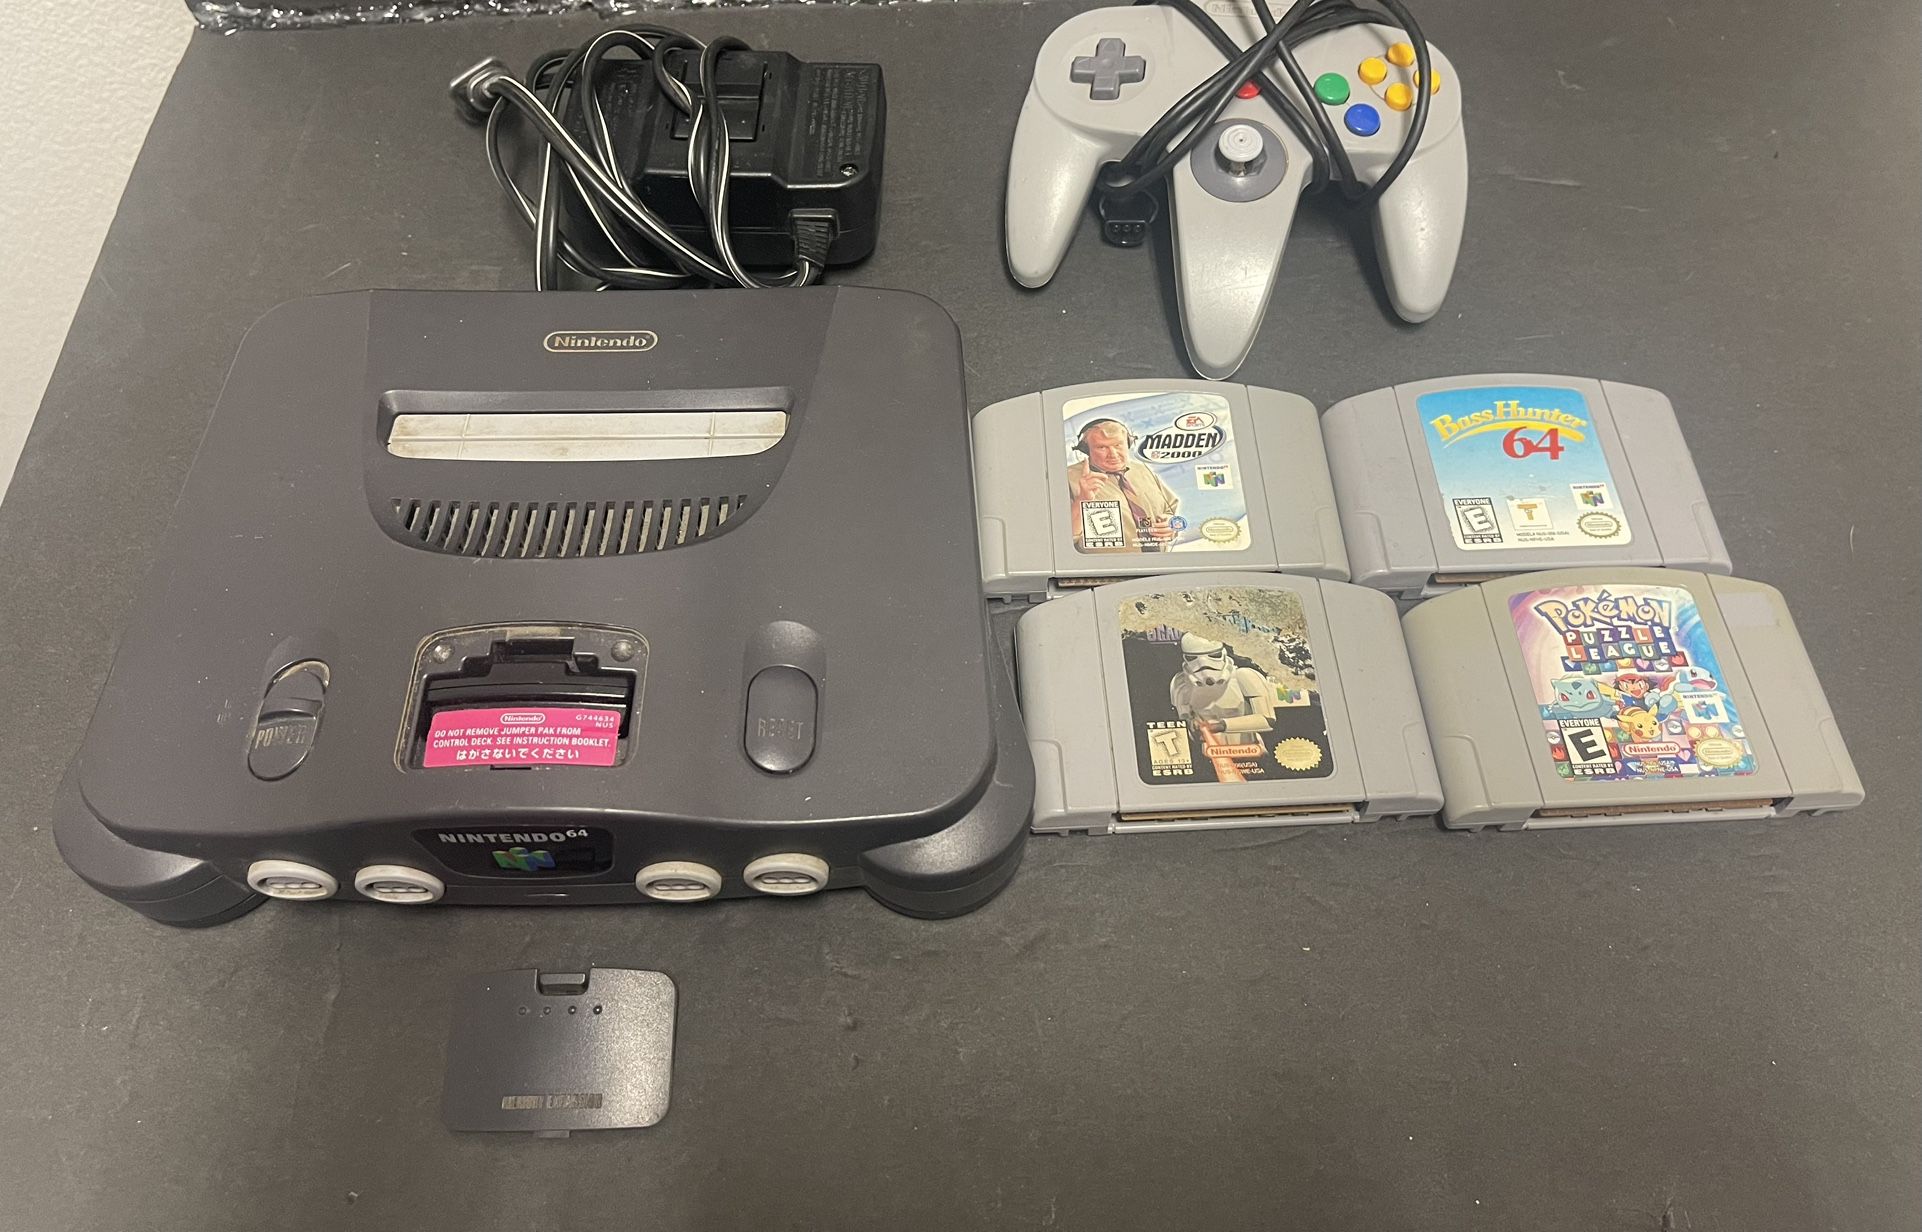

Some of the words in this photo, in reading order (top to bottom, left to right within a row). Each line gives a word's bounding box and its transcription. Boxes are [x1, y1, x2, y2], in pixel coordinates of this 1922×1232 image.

[554, 336, 647, 347] Nintendo
[1429, 408, 1495, 441] Bass
[1494, 400, 1588, 427] Hunter
[1145, 433, 1218, 449] MADDEN
[1503, 426, 1565, 460] 64
[1091, 511, 1117, 535] E
[1464, 507, 1493, 532] E
[1565, 626, 1665, 644] PUZZLE
[1571, 642, 1671, 660] LEAGUE
[1560, 719, 1600, 727] EVERYONE
[434, 730, 446, 738] DO
[447, 729, 465, 737] NOT
[466, 727, 499, 736] REMOVE
[501, 727, 536, 735] JUMPER
[537, 727, 555, 735] PAK
[557, 727, 581, 736] FROM
[433, 738, 468, 748] CONTROL
[496, 737, 512, 745] SEE
[513, 736, 570, 745] INSTRUCTION
[571, 737, 612, 747] BOOKLET.
[1154, 731, 1178, 756] T
[1568, 729, 1607, 761] E
[1629, 745, 1676, 753] Nintendo
[456, 748, 580, 760] はがさないでください
[1211, 747, 1258, 756] Nintendo
[438, 833, 566, 843] NINTENDO
[566, 829, 589, 838] 64
